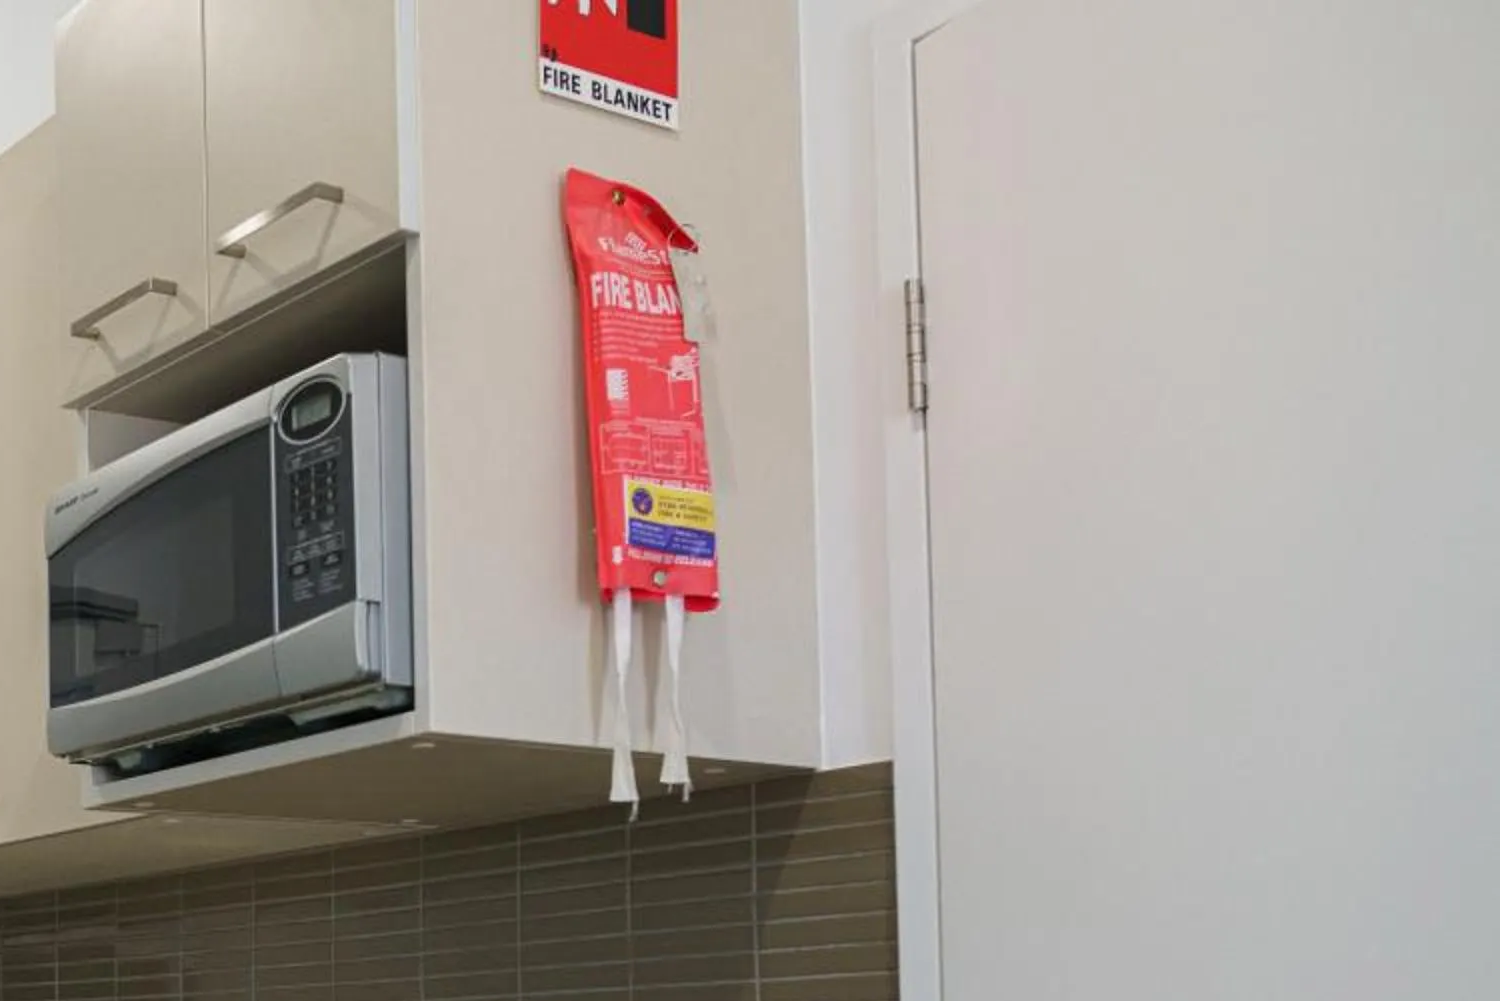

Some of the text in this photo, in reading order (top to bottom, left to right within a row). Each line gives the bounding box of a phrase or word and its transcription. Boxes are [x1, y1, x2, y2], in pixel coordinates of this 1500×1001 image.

[543, 66, 673, 121] FIRE BLANKET
[590, 271, 633, 309] FIRE
